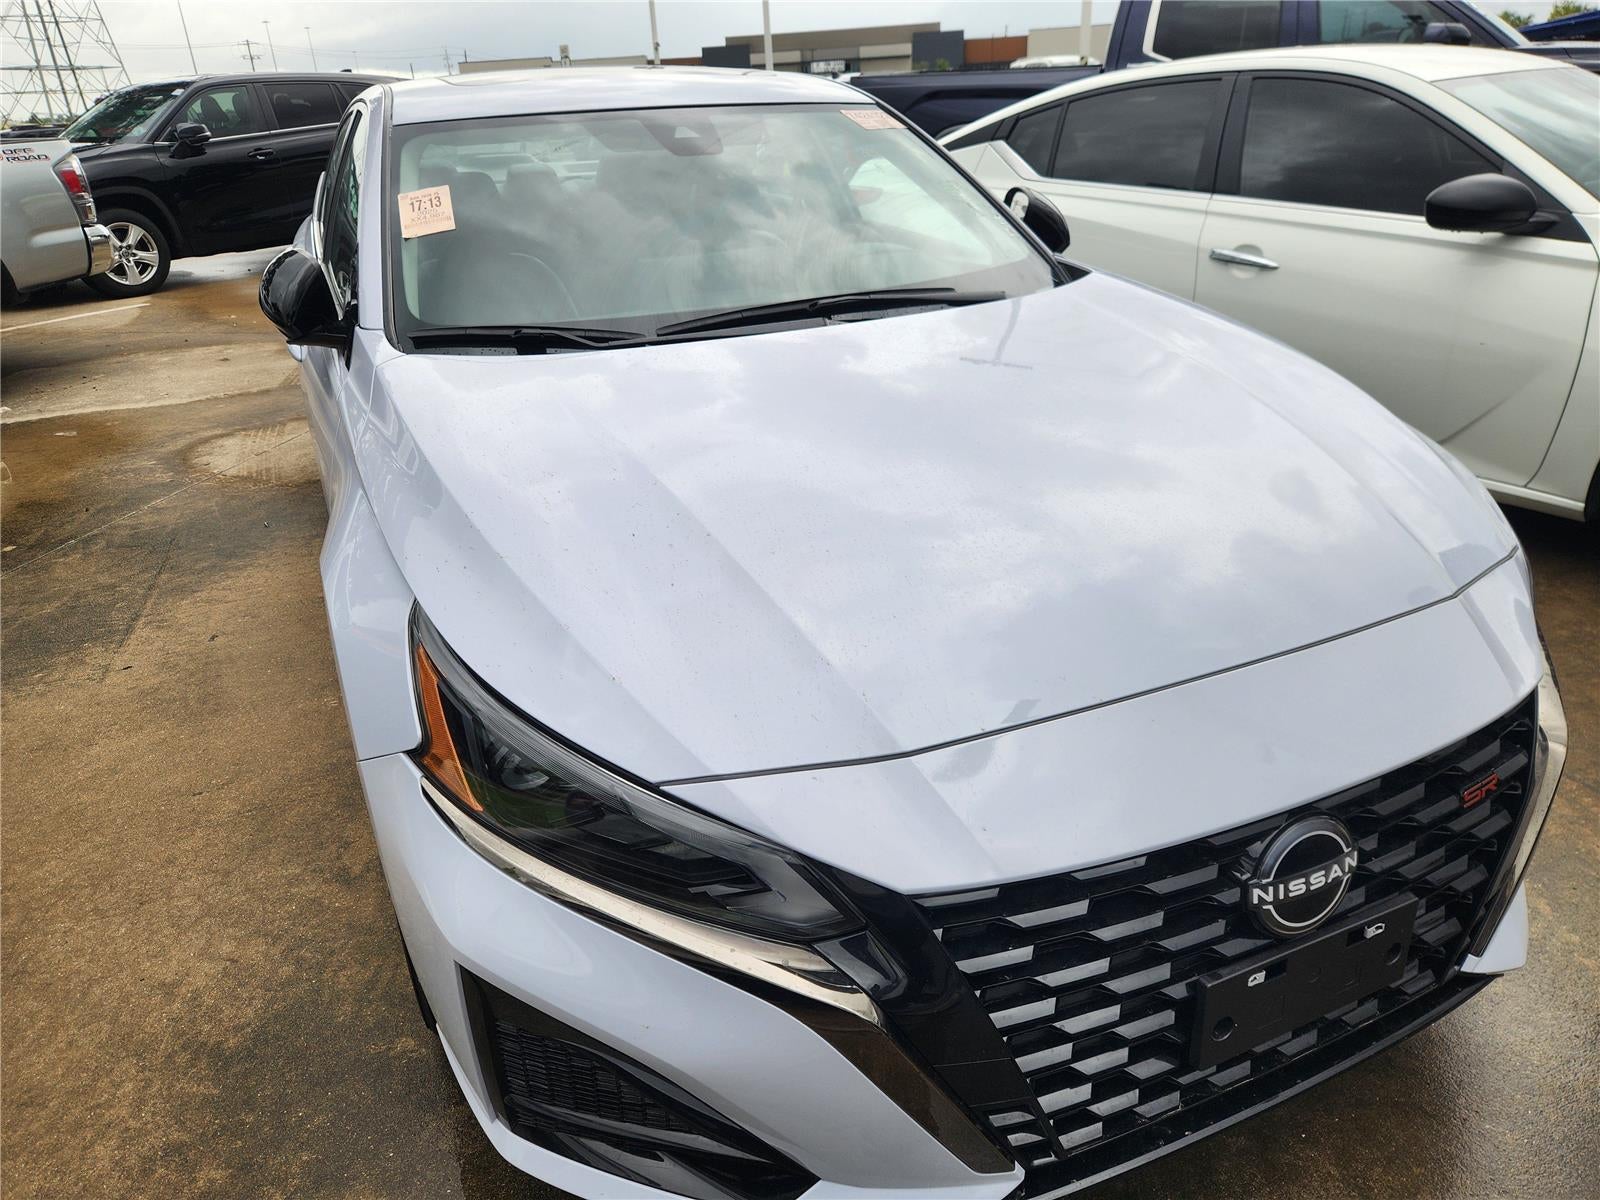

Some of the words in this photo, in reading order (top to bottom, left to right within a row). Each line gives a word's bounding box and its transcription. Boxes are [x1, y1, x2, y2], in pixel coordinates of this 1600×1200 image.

[2, 147, 33, 155] OFF
[6, 154, 50, 162] ROAD
[409, 195, 442, 212] 17:13
[1463, 772, 1498, 809] SR
[1252, 850, 1358, 905] NISSAN
